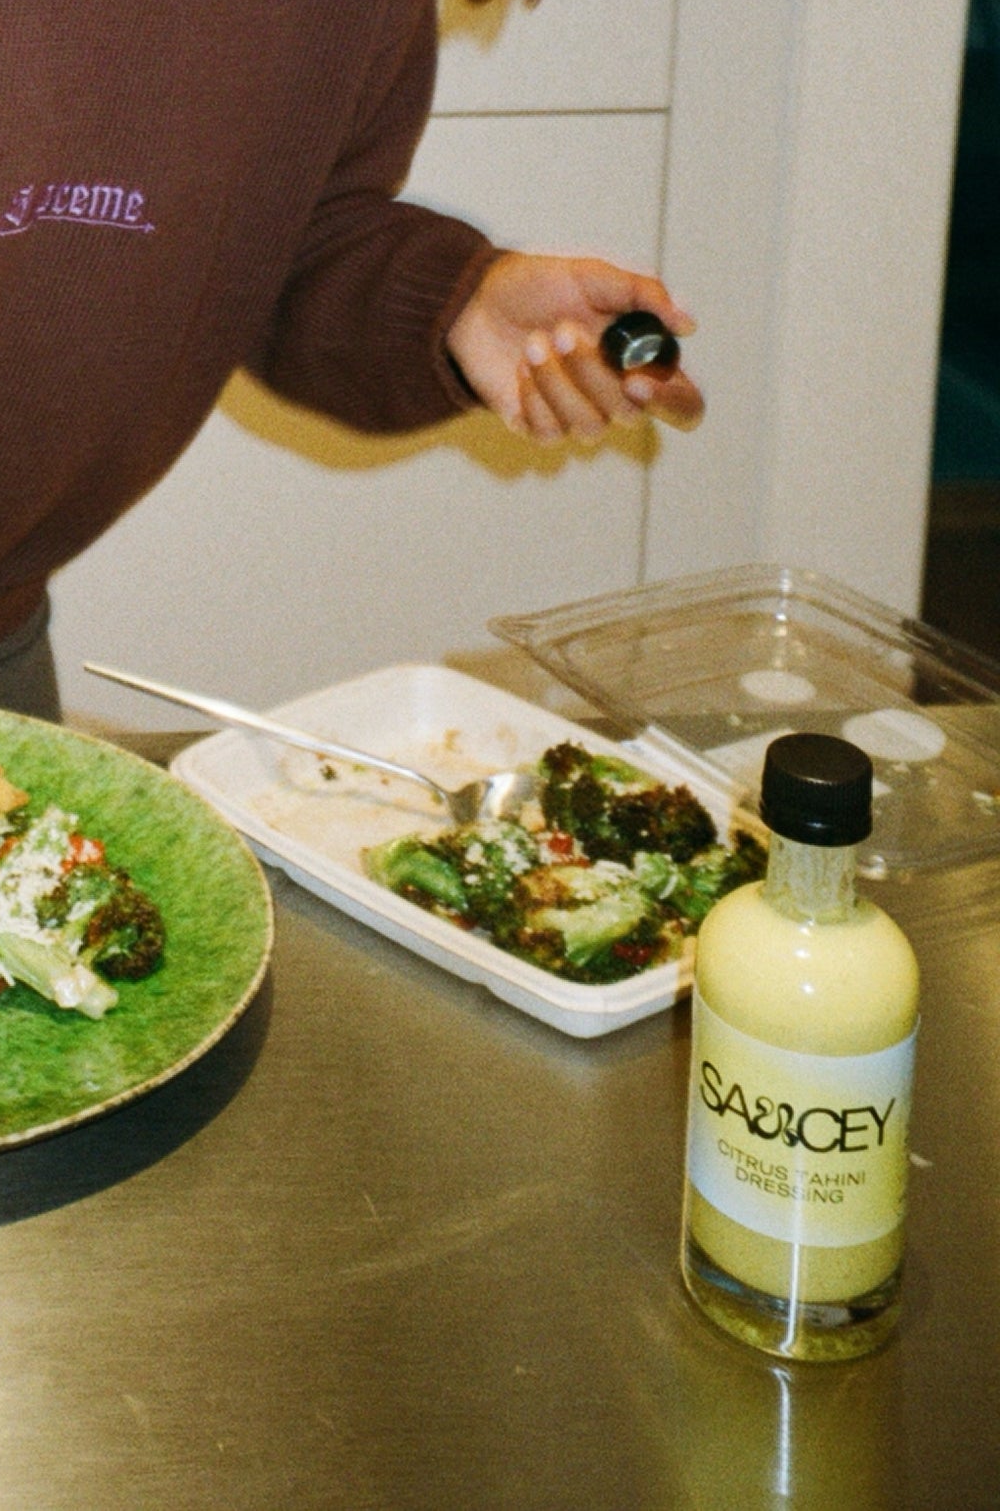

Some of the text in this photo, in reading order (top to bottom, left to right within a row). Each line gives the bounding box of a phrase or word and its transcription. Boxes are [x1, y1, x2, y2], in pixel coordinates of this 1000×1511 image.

[717, 1138, 867, 1187] CITRUS TAHINI
[735, 1165, 844, 1204] DRESSING
